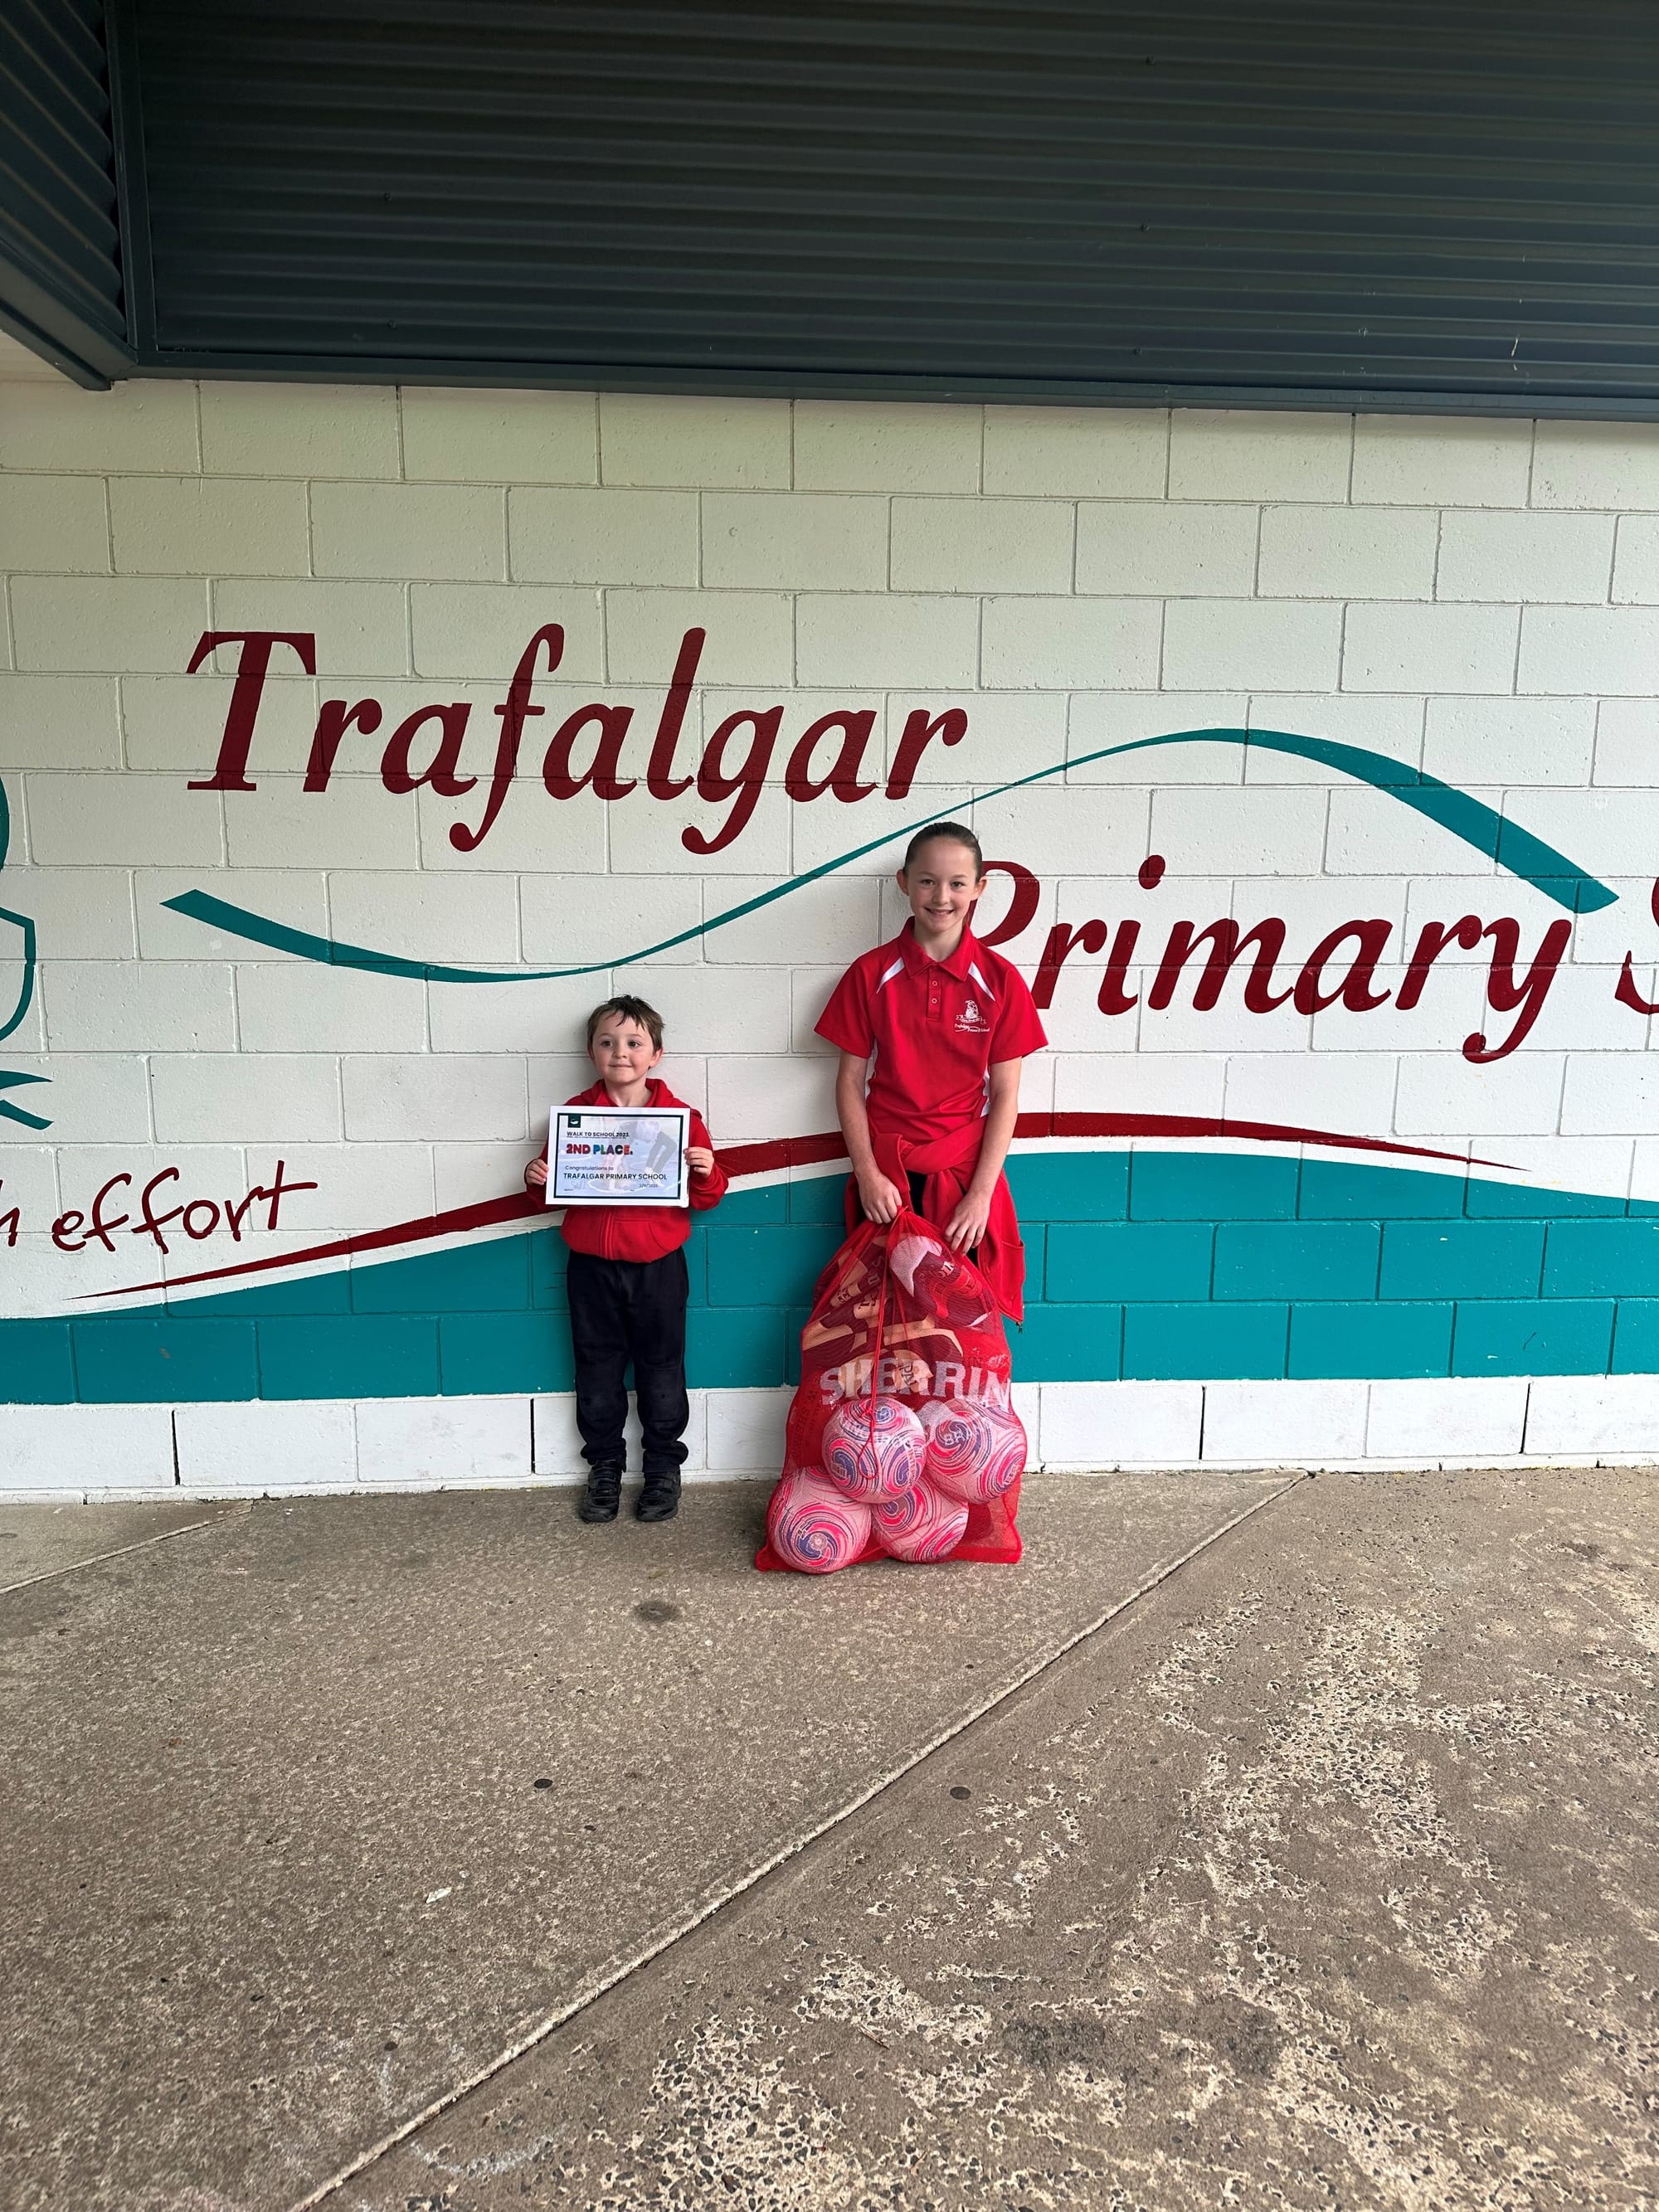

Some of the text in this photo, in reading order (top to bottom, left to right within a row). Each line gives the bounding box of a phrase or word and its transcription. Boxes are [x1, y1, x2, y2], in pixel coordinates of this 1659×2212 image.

[187, 624, 968, 854] Trafalgar
[963, 859, 1572, 1064] Primary
[566, 1143, 634, 1155] 2ND PLACE.
[51, 1159, 319, 1254] effort
[820, 1357, 1012, 1412] SHERRIN
